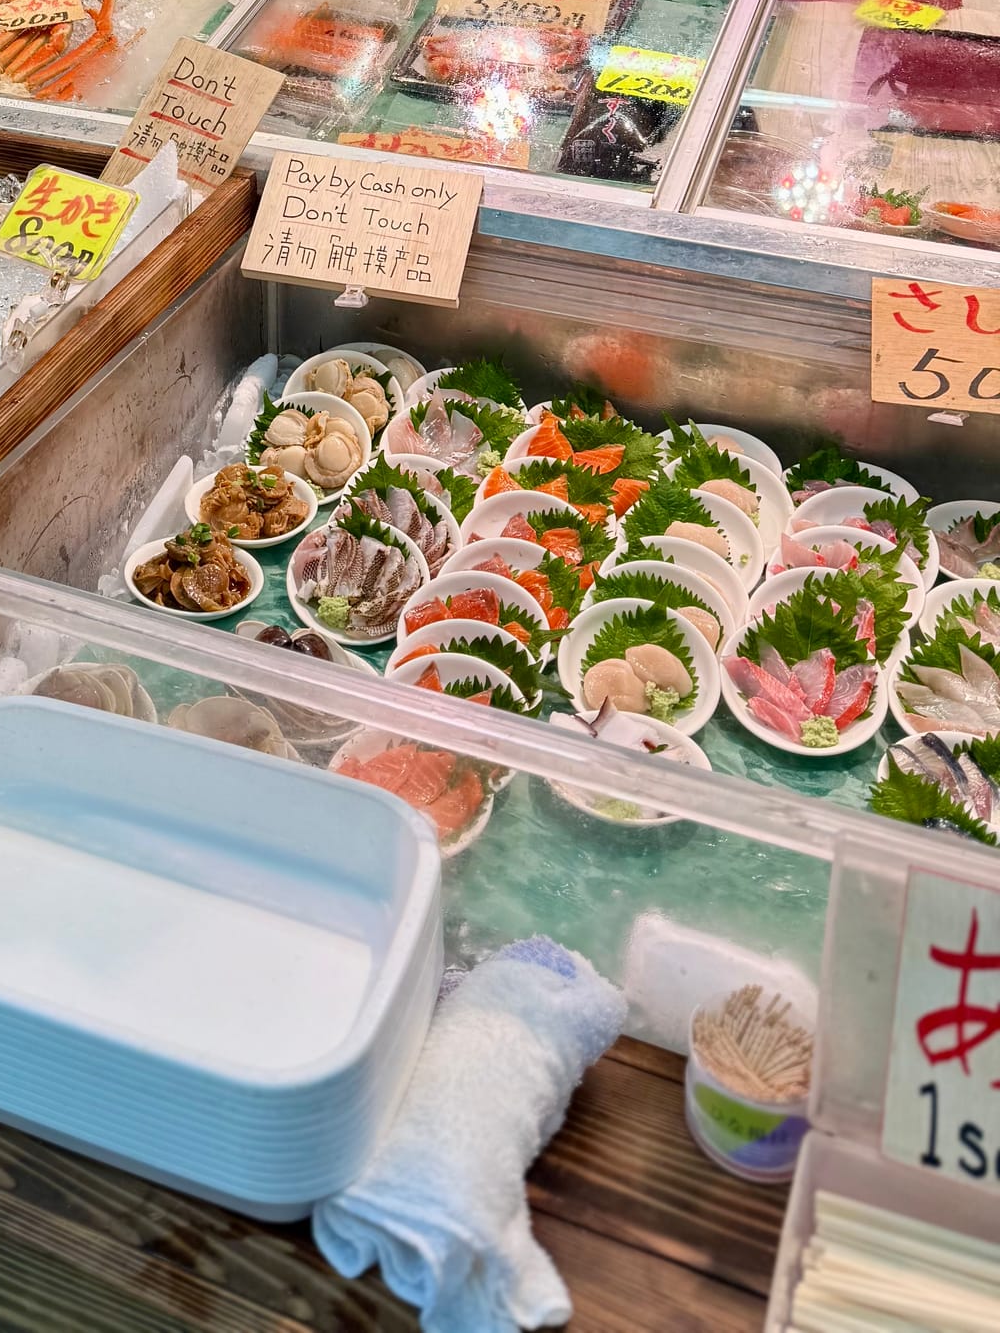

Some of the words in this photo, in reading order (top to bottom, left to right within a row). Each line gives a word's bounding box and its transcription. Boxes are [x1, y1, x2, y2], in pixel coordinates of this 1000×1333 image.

[173, 56, 237, 101] Don't
[161, 92, 228, 135] Touch
[14, 174, 121, 238] 生かき
[284, 159, 326, 194] Pay
[328, 165, 356, 198] by
[360, 172, 406, 196] Cash
[411, 181, 458, 211] only
[282, 195, 348, 224] Don't
[363, 206, 430, 236] Touch
